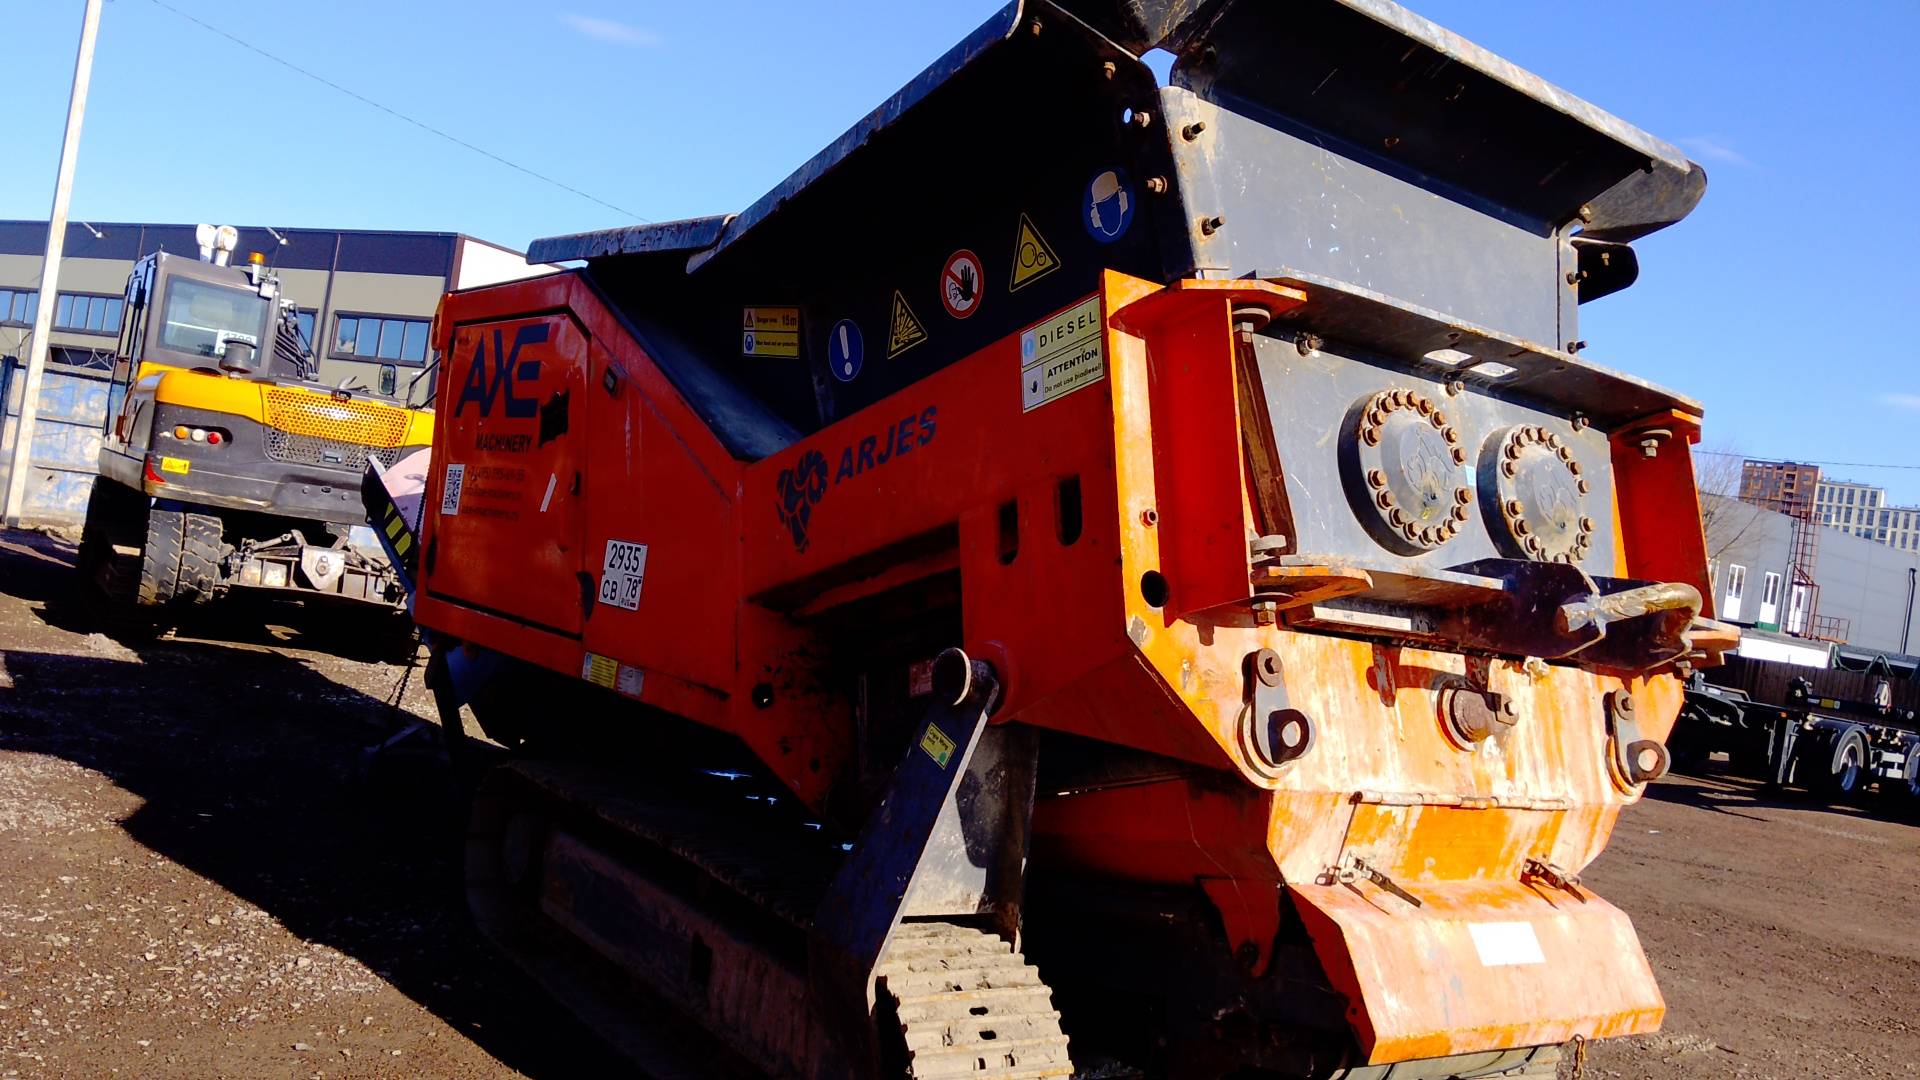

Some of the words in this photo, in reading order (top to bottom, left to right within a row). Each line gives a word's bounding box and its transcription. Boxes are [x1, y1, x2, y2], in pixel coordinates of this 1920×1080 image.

[1039, 311, 1097, 348] DIESEL
[454, 322, 551, 418] AXE
[1047, 348, 1098, 379] ATTENTION
[1044, 385, 1053, 393] Do
[1053, 381, 1063, 389] not
[476, 432, 532, 453] MACHINERY
[834, 405, 938, 485] ARJES
[608, 543, 641, 572] 2935
[602, 579, 618, 600] CB
[625, 577, 638, 599] 78
